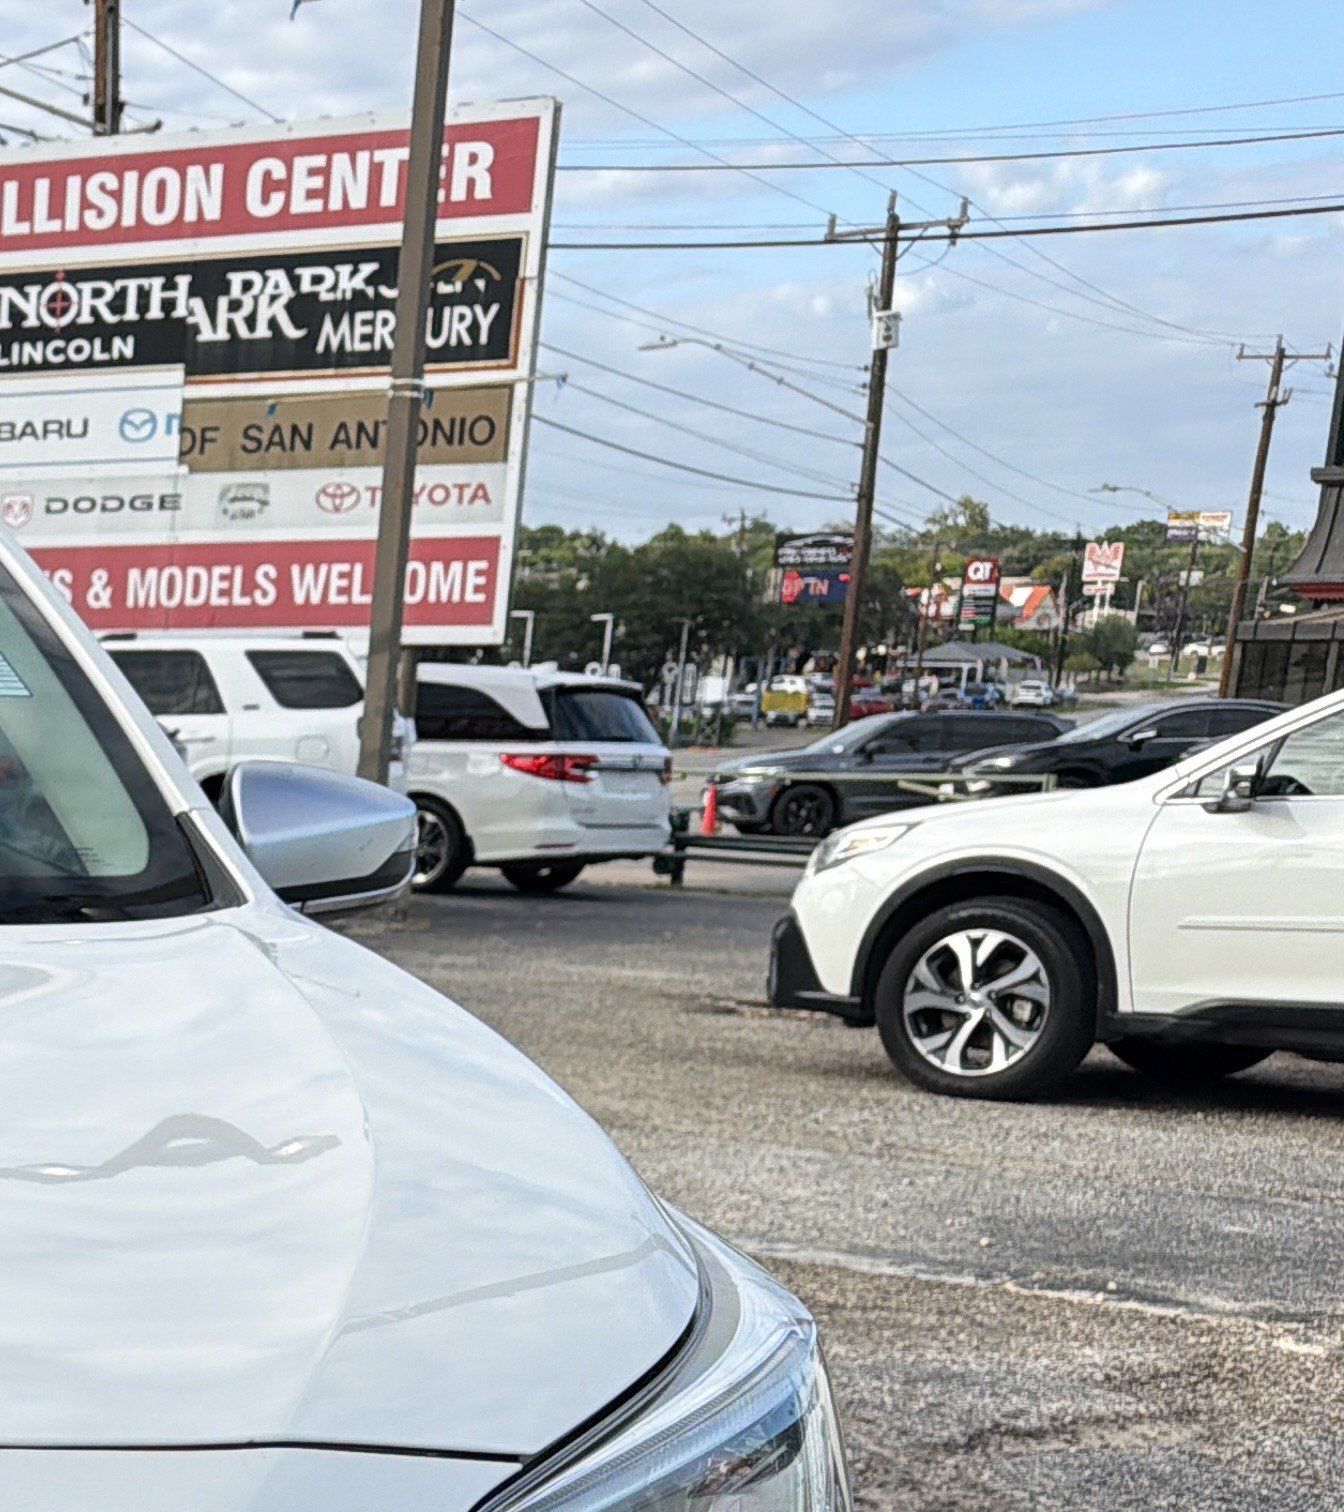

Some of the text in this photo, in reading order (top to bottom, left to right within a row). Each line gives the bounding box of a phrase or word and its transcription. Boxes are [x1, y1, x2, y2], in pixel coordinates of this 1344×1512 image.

[245, 140, 494, 218] CENTR
[186, 295, 309, 342] ARK
[315, 302, 500, 354] MERURY
[241, 422, 314, 453] SAN
[329, 414, 496, 451] ANNIO
[45, 482, 491, 515] DODGE TYOTA
[86, 568, 113, 609] &
[126, 563, 278, 609] MODELS
[290, 560, 490, 606] WELOME
[967, 561, 994, 581] QT
